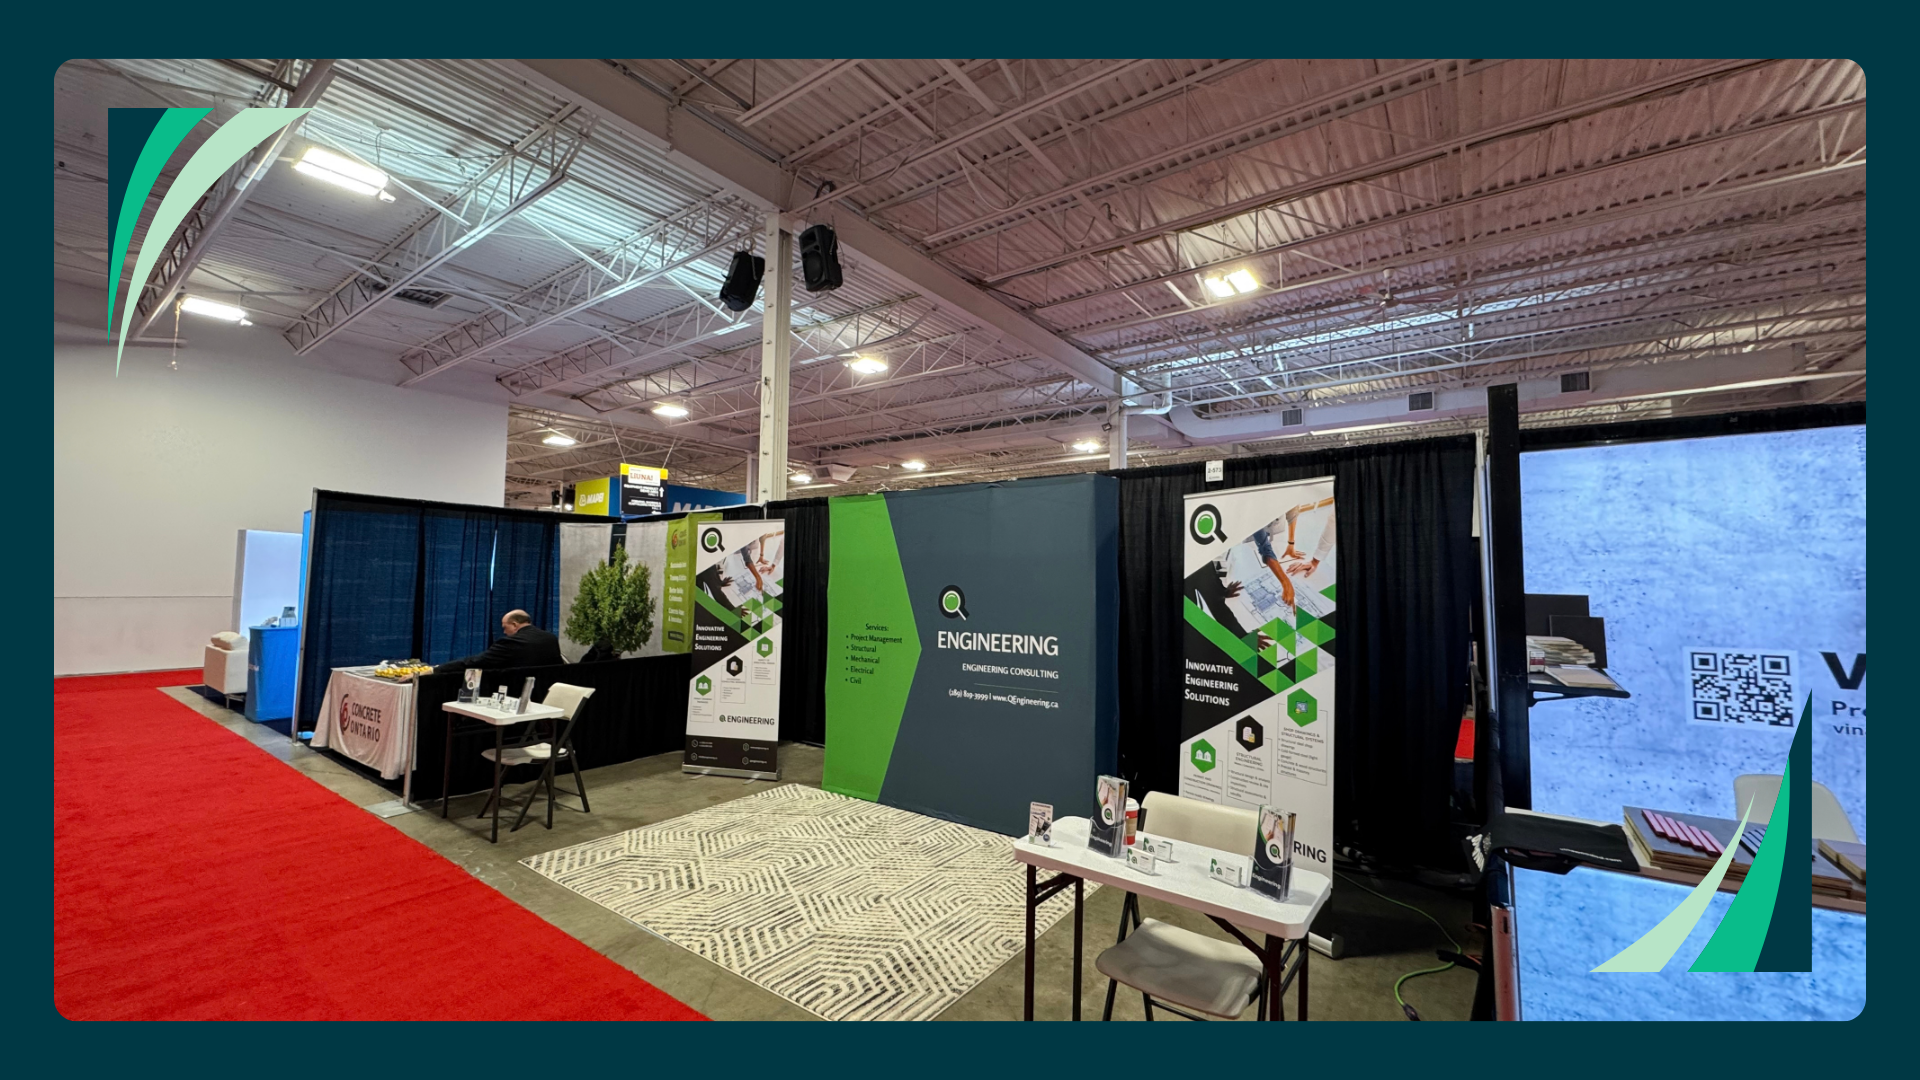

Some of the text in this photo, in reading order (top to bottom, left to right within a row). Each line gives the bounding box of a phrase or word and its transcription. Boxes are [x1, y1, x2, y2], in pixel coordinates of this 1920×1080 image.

[865, 622, 889, 631] Services:
[850, 633, 903, 645] Project Management
[937, 630, 1059, 656] ENGINEERING
[850, 644, 877, 653] Structural
[850, 655, 880, 664] Mechanical
[850, 666, 875, 675] Electrical
[962, 663, 1059, 680] ENGINEERING CONSULTING
[849, 677, 862, 685] Civil
[351, 702, 382, 724] CONCRETE
[726, 715, 775, 725] ENGINEERING
[350, 720, 381, 742] ONTARIO
[1832, 723, 1867, 736] vin
